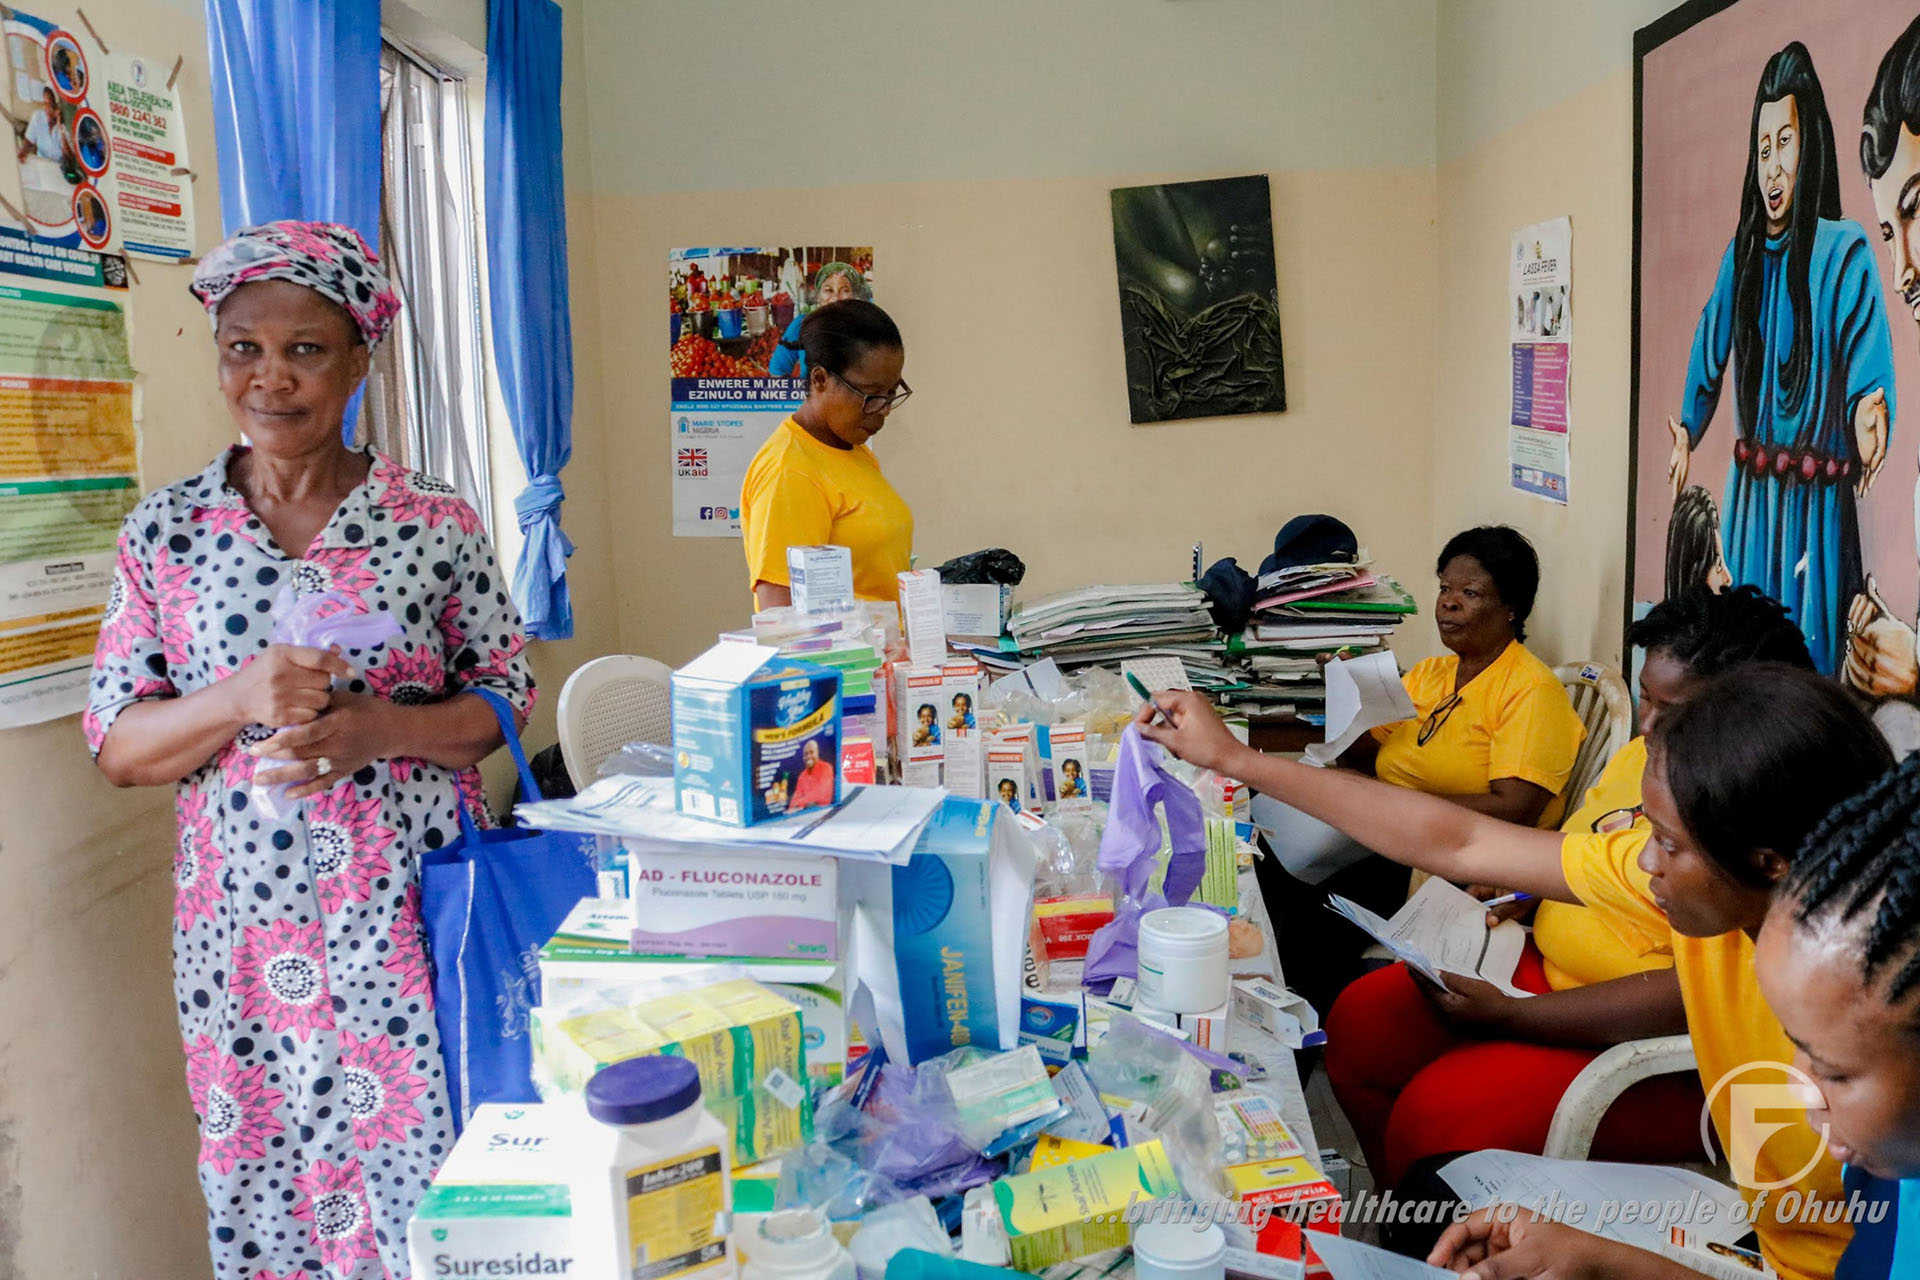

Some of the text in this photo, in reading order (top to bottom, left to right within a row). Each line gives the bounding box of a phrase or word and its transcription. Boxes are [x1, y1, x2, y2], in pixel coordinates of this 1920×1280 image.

[109, 101, 130, 118] 0800
[1523, 259, 1557, 276] LASSA FEVER
[698, 379, 750, 388] ENWERE
[753, 380, 764, 388] M
[767, 380, 789, 388] IKE
[688, 391, 743, 400] EZINULO
[746, 391, 758, 400] M
[761, 391, 788, 400] NKE
[639, 869, 664, 882] AD
[681, 870, 822, 887] FLUCONAZOLE
[652, 887, 709, 898] Fluconazole
[711, 888, 744, 899] Tablets
[747, 890, 769, 901] USP
[792, 894, 808, 903] mg
[433, 1252, 574, 1277] Suresidar
